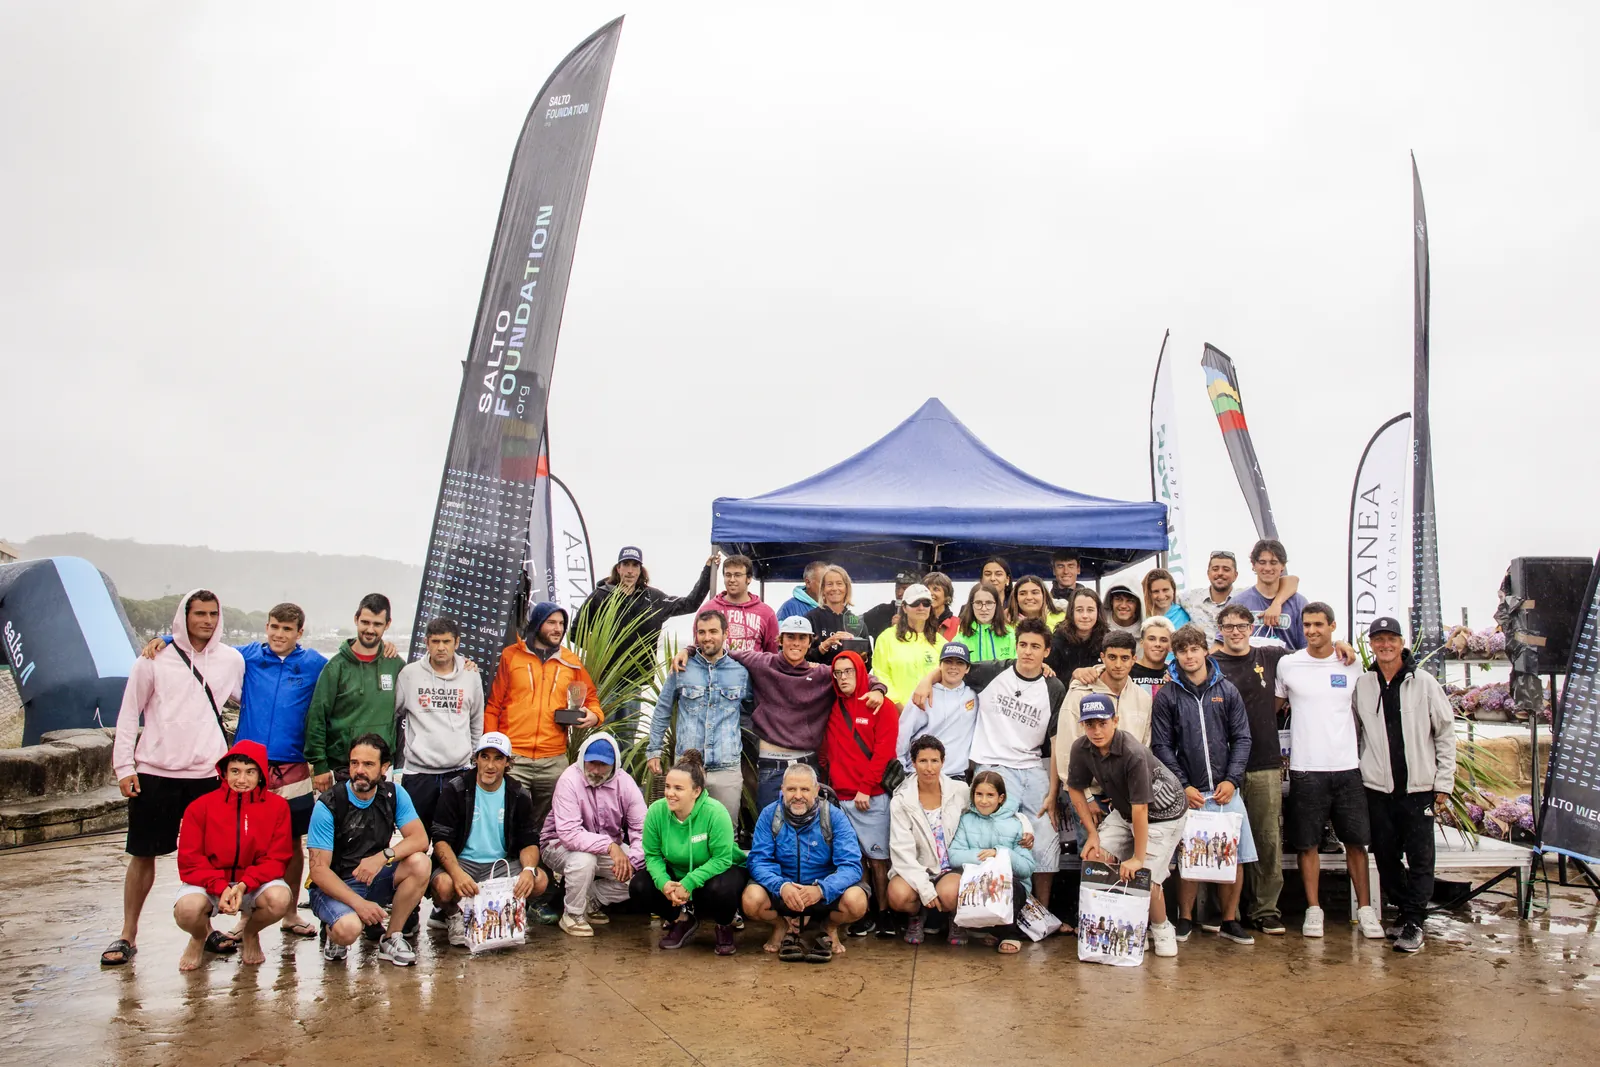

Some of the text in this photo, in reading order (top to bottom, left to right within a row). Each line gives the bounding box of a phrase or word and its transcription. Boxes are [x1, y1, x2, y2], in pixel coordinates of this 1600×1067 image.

[545, 103, 590, 119] FOUNDATION
[549, 94, 571, 107] SALTO
[494, 205, 554, 417] FOUNDATION
[478, 310, 511, 414] SALTO
[516, 385, 531, 419] .org
[4, 620, 24, 668] salto
[418, 687, 458, 695] BASQUE
[431, 700, 457, 709] TEAM
